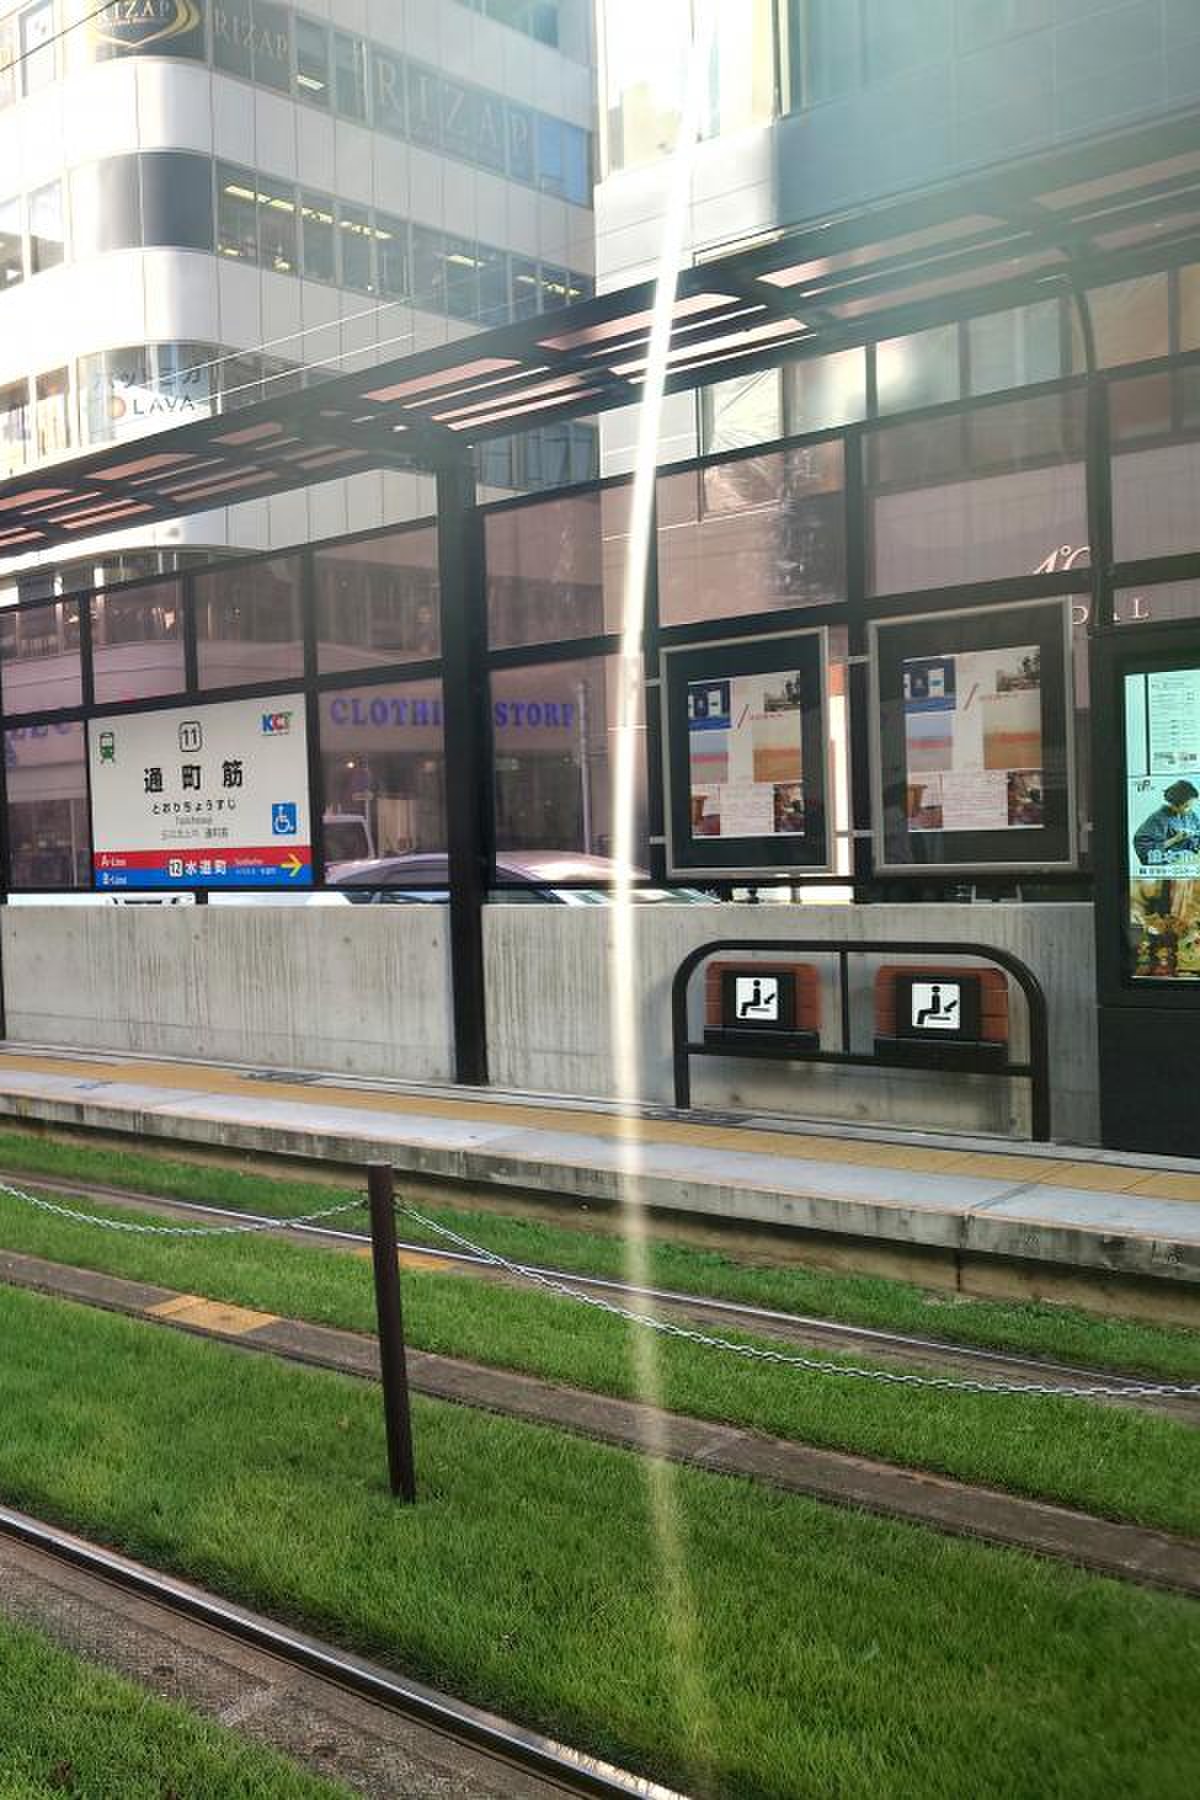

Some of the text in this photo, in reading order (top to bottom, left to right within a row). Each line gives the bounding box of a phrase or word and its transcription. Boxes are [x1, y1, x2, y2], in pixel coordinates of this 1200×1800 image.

[377, 58, 528, 150] RIZAP
[133, 394, 195, 416] LAVA
[144, 760, 243, 793] 通町筋
[152, 799, 236, 815] とおりちょうすじ
